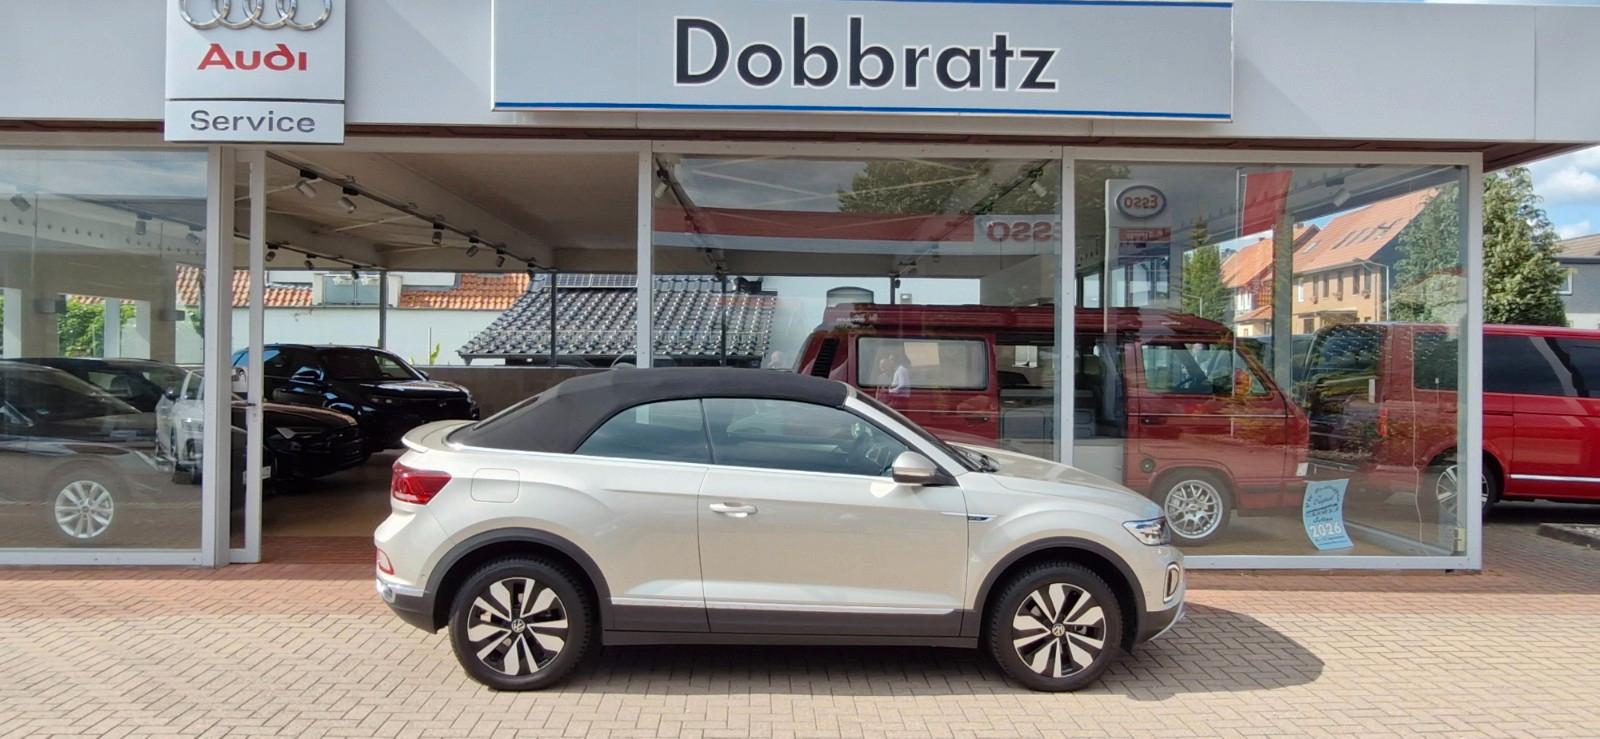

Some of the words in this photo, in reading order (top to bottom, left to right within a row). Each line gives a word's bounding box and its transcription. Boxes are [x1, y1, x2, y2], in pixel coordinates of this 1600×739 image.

[198, 43, 307, 70] Audi
[675, 15, 1059, 91] Dobbratz
[190, 110, 315, 132] Service
[1310, 522, 1341, 537] 2026
